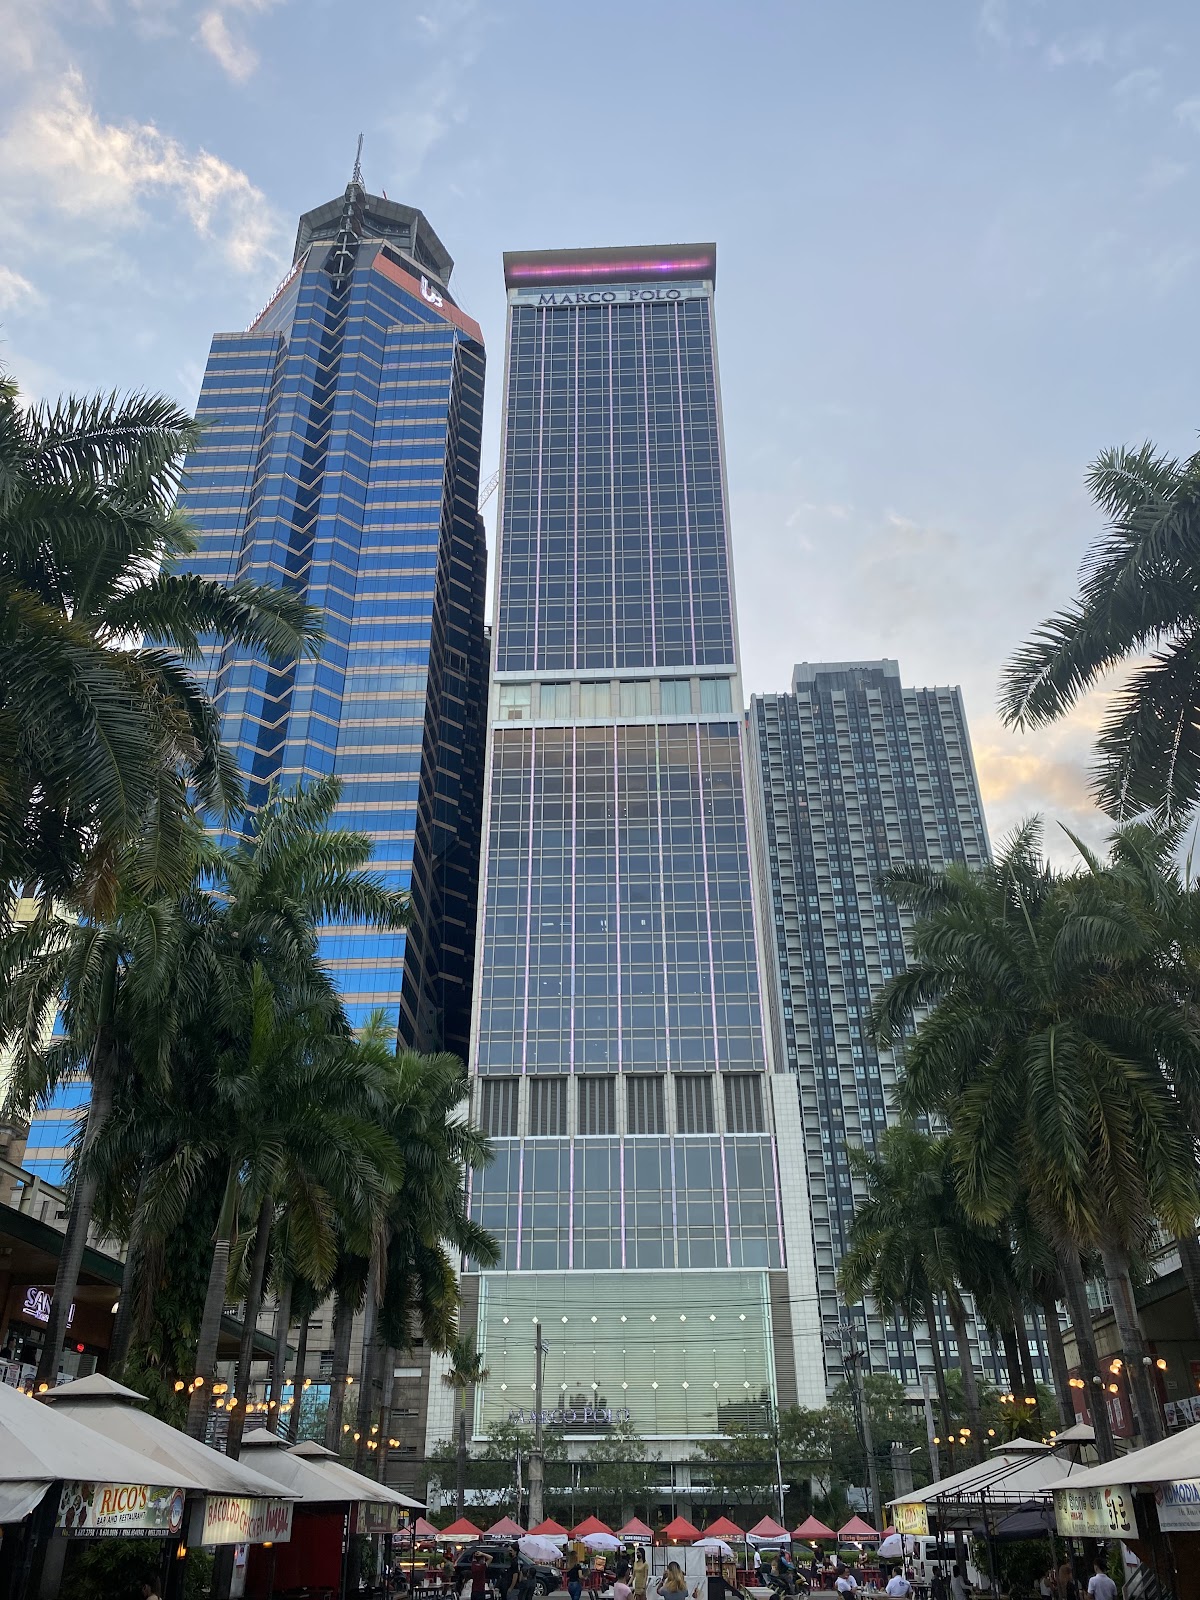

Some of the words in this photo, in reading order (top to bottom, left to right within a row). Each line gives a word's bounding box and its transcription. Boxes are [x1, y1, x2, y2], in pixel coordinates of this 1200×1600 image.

[538, 292, 617, 305] MARCO
[628, 289, 681, 301] POLO
[583, 1406, 630, 1425] POLO
[100, 1485, 148, 1516] RICO'S
[1068, 1492, 1087, 1511] Stone
[96, 1516, 106, 1525] BAR
[107, 1514, 118, 1524] AND
[119, 1511, 146, 1522] RESTAURANT
[207, 1500, 240, 1527] BACOLOD
[240, 1510, 265, 1538] CHICKEN
